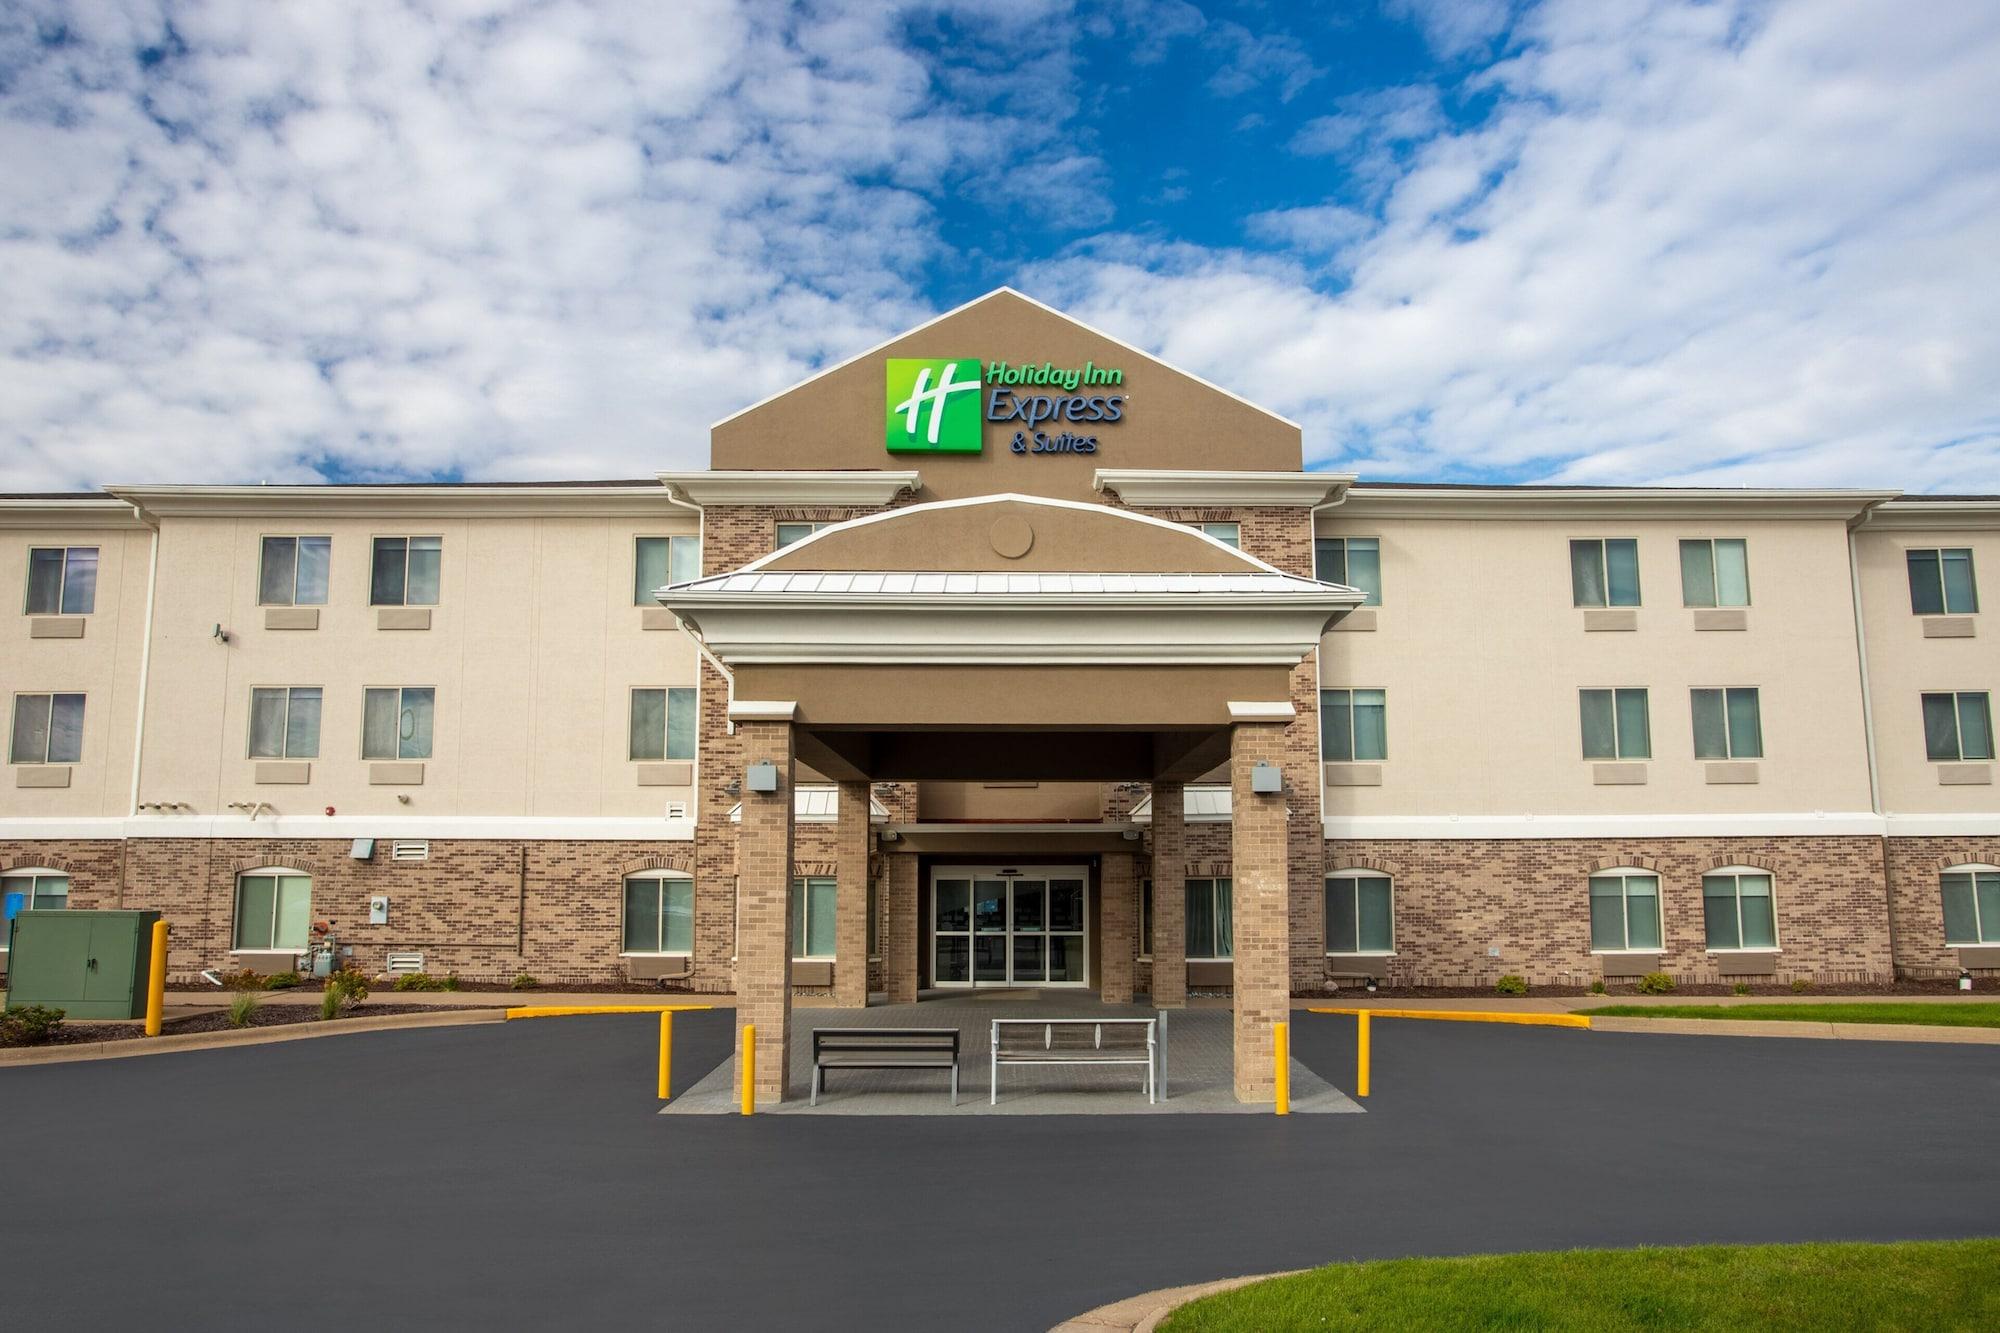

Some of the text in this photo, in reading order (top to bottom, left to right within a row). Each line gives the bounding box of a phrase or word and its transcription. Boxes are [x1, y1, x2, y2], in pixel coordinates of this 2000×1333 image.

[986, 361, 1122, 389] Holiday Inn
[895, 363, 981, 443] H
[987, 387, 1122, 429] Express
[1010, 432, 1098, 453] & Suites
